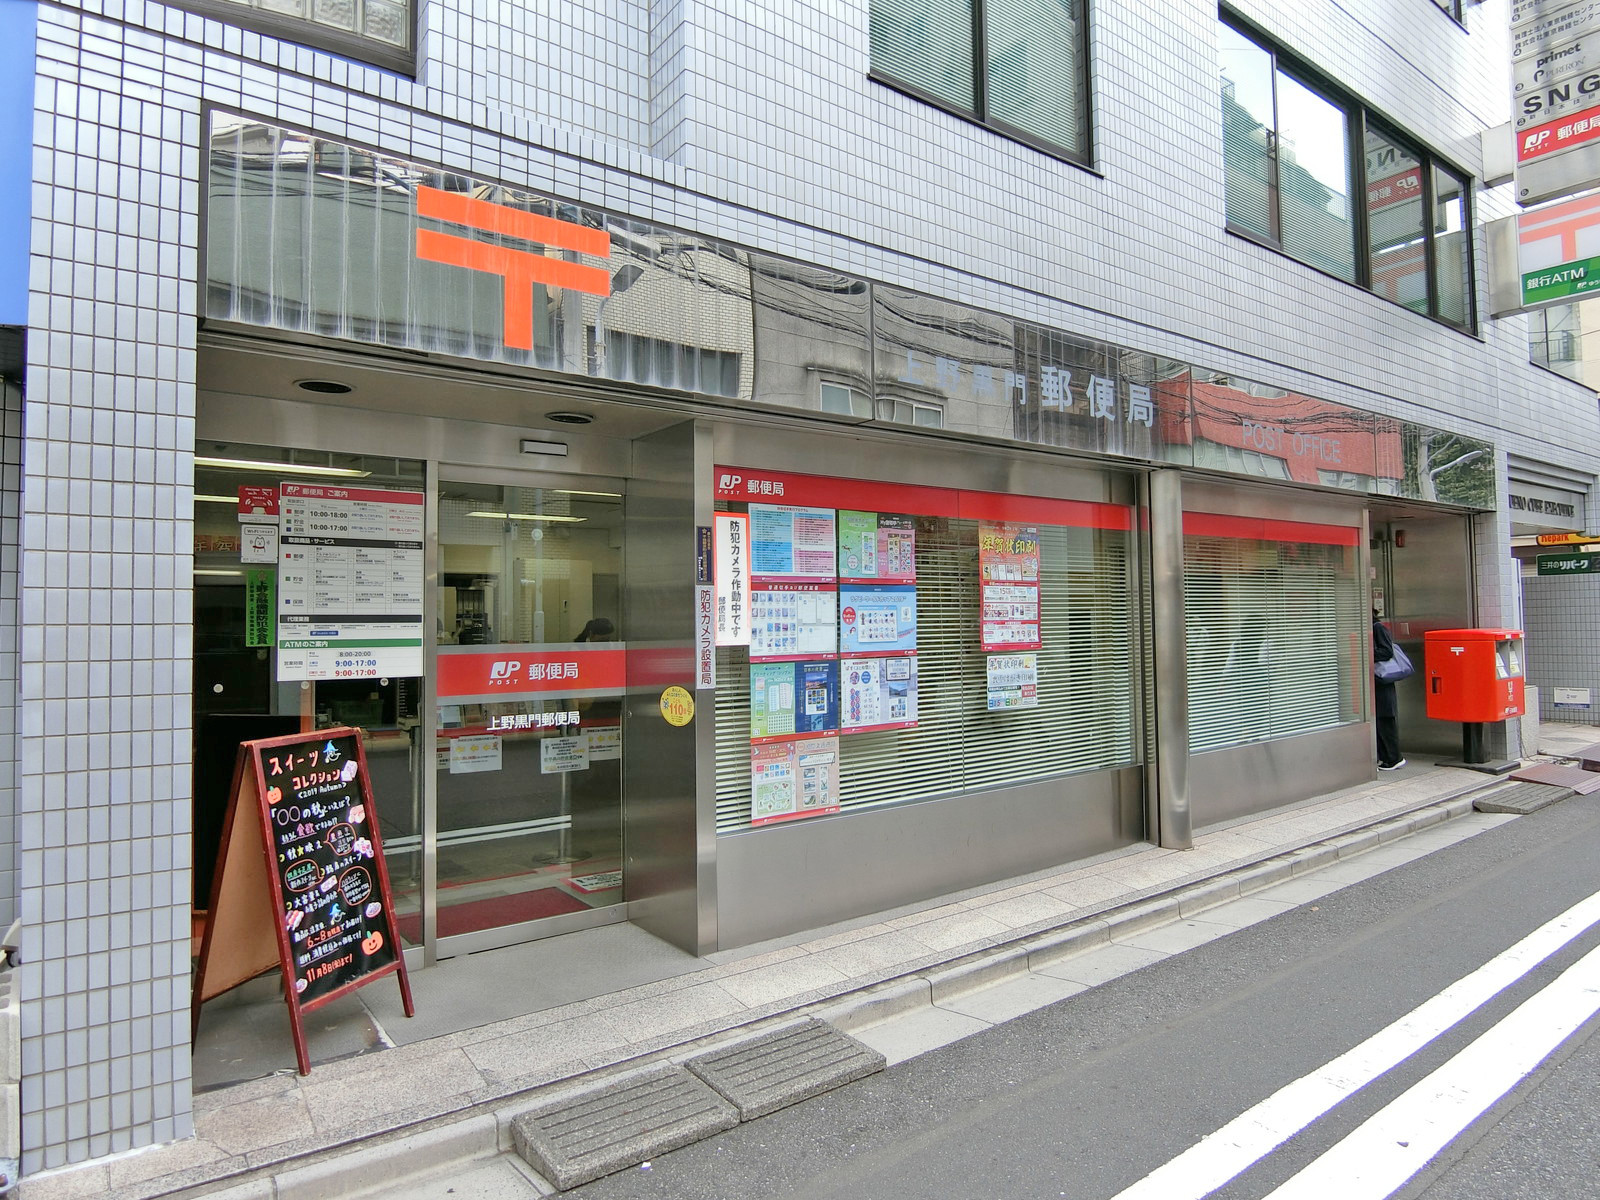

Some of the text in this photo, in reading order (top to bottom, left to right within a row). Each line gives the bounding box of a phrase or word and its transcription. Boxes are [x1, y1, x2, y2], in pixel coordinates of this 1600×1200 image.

[1537, 42, 1581, 68] primet
[1523, 143, 1549, 154] POST
[1526, 267, 1585, 290] 銀行ATM
[1242, 420, 1342, 463] POST OFFICE
[747, 479, 784, 497] 郵便局
[309, 511, 348, 519] 10:00-18:00
[309, 524, 348, 532] 10:00-17:00
[981, 536, 1037, 556] 年賀状印刷
[1541, 559, 1589, 571] 三井のリパーク
[730, 520, 742, 637] 防犯カメラ作動中です
[284, 640, 329, 648] ATMのご案内
[700, 589, 712, 686] 防犯カメラ設置局
[335, 659, 377, 668] 9:00-17:00
[335, 669, 377, 677] 9:00-17:00
[528, 662, 579, 681] 郵便局
[486, 711, 580, 731] 上野黒門郵便局
[269, 750, 319, 776] スイーツ
[292, 769, 341, 791] コレクション
